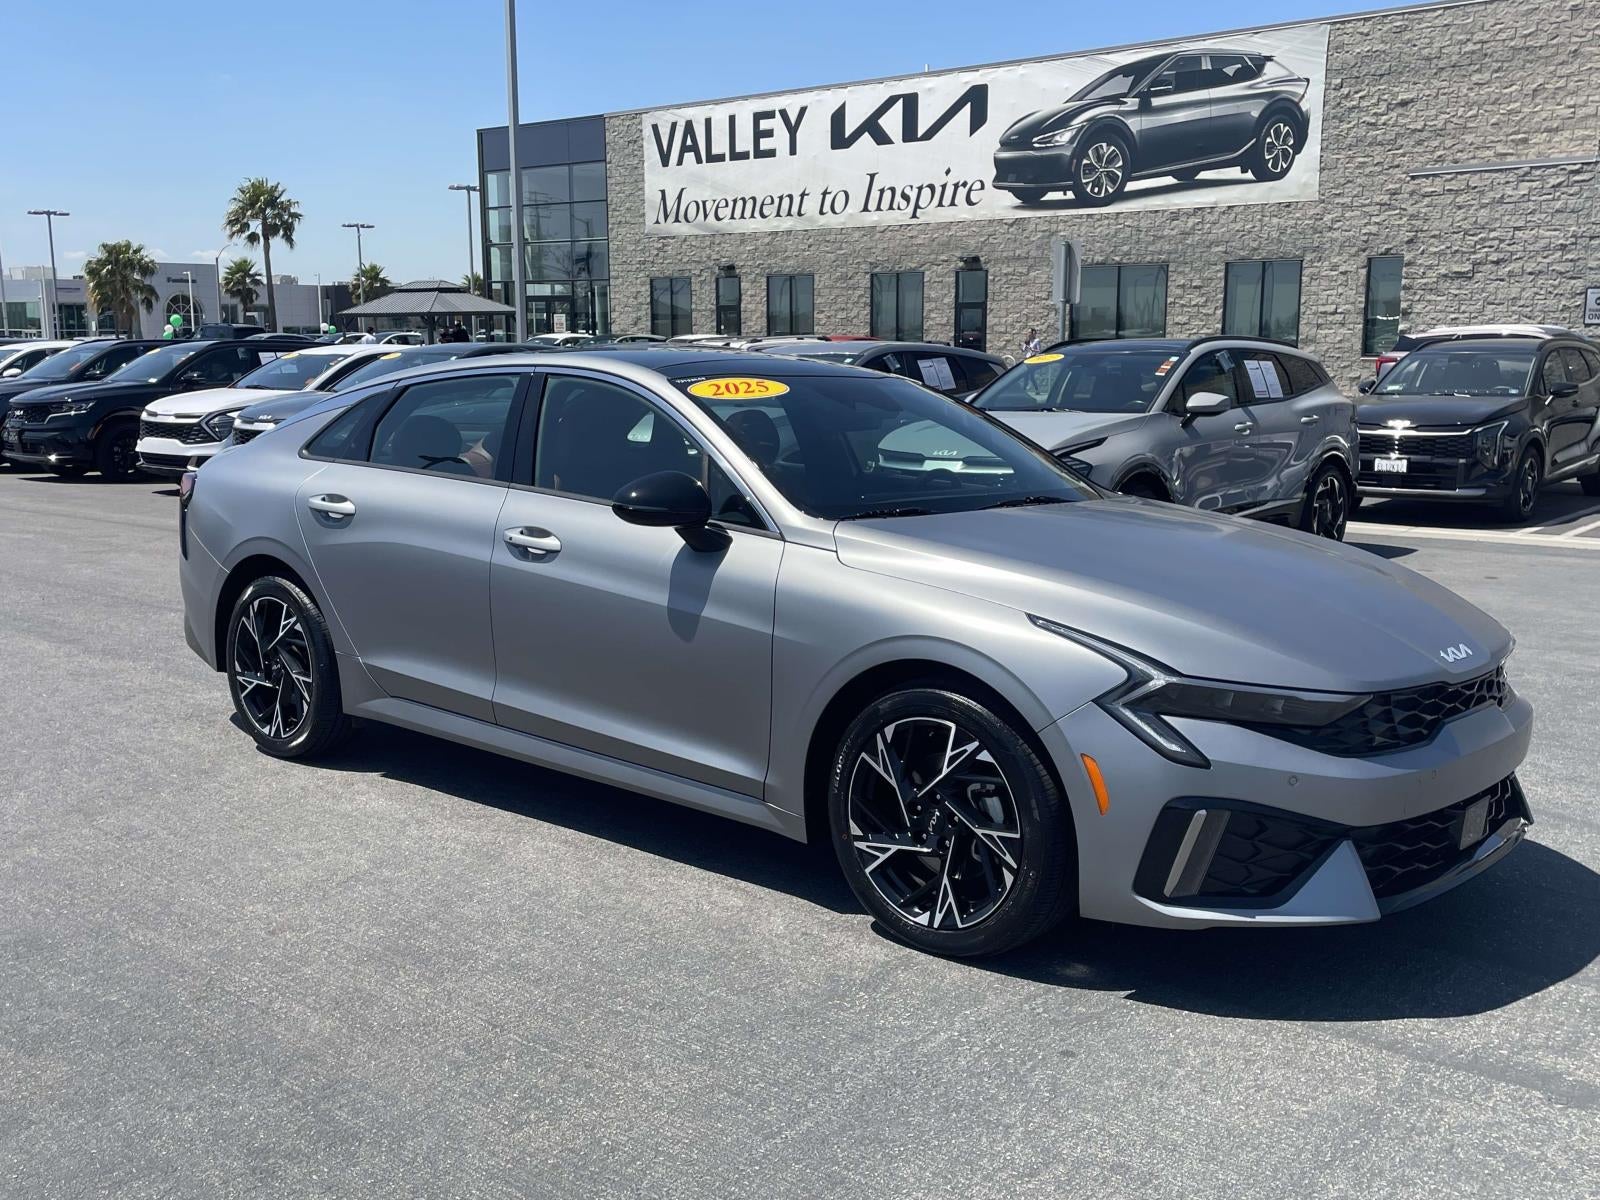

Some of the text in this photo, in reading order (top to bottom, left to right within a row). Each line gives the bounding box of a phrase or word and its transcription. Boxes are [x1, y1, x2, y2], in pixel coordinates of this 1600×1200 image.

[651, 83, 989, 168] VALLEY KIA
[653, 167, 986, 225] Movement to Inspire
[708, 379, 770, 397] 2025
[1439, 643, 1473, 663] KIA
